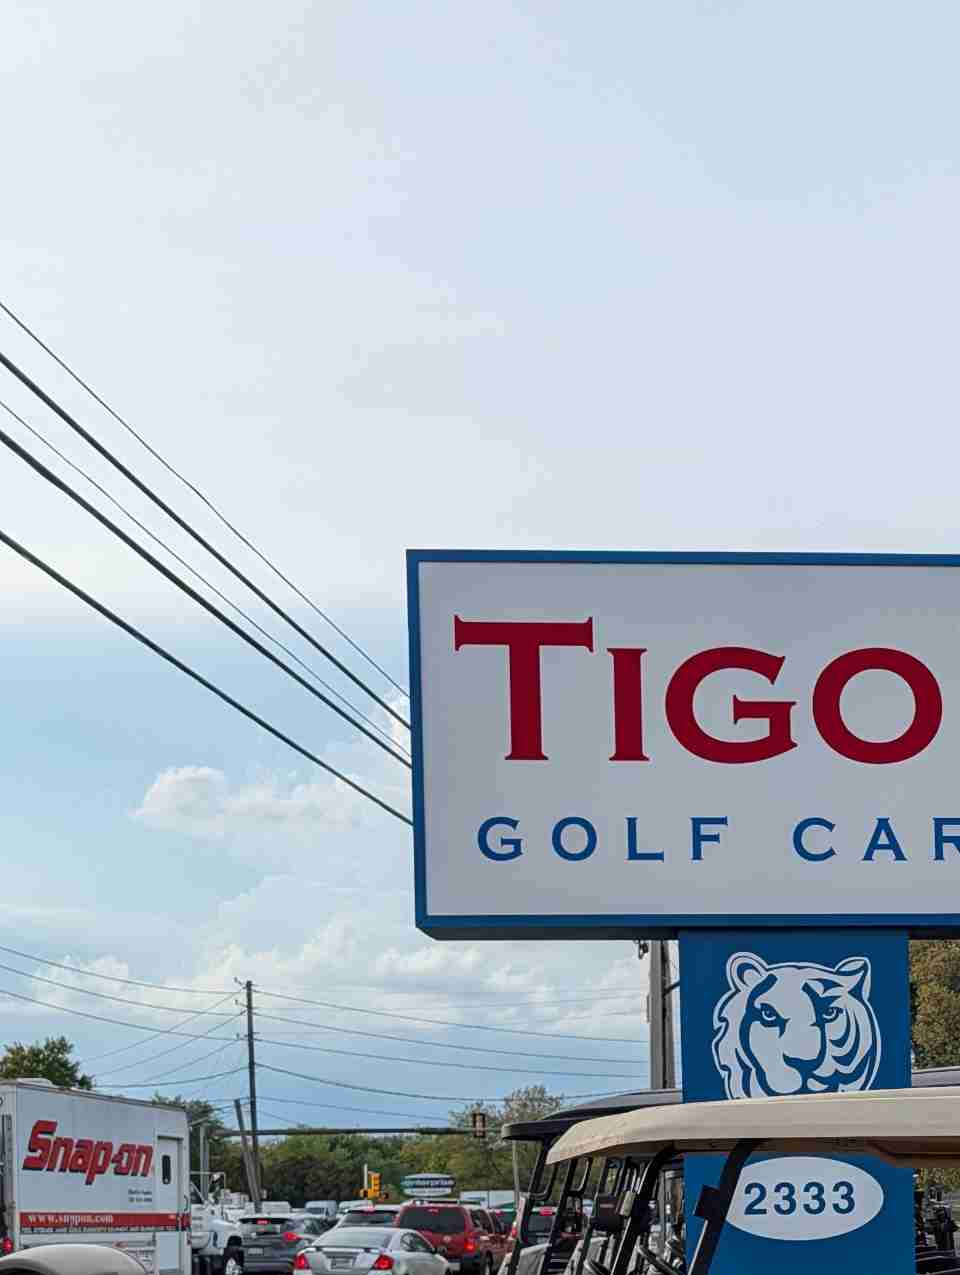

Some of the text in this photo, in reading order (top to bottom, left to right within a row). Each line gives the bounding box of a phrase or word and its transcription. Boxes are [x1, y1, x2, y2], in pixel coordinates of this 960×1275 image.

[476, 816, 729, 863] GOLF
[22, 1119, 154, 1186] Snap-on
[743, 1180, 857, 1216] 2333
